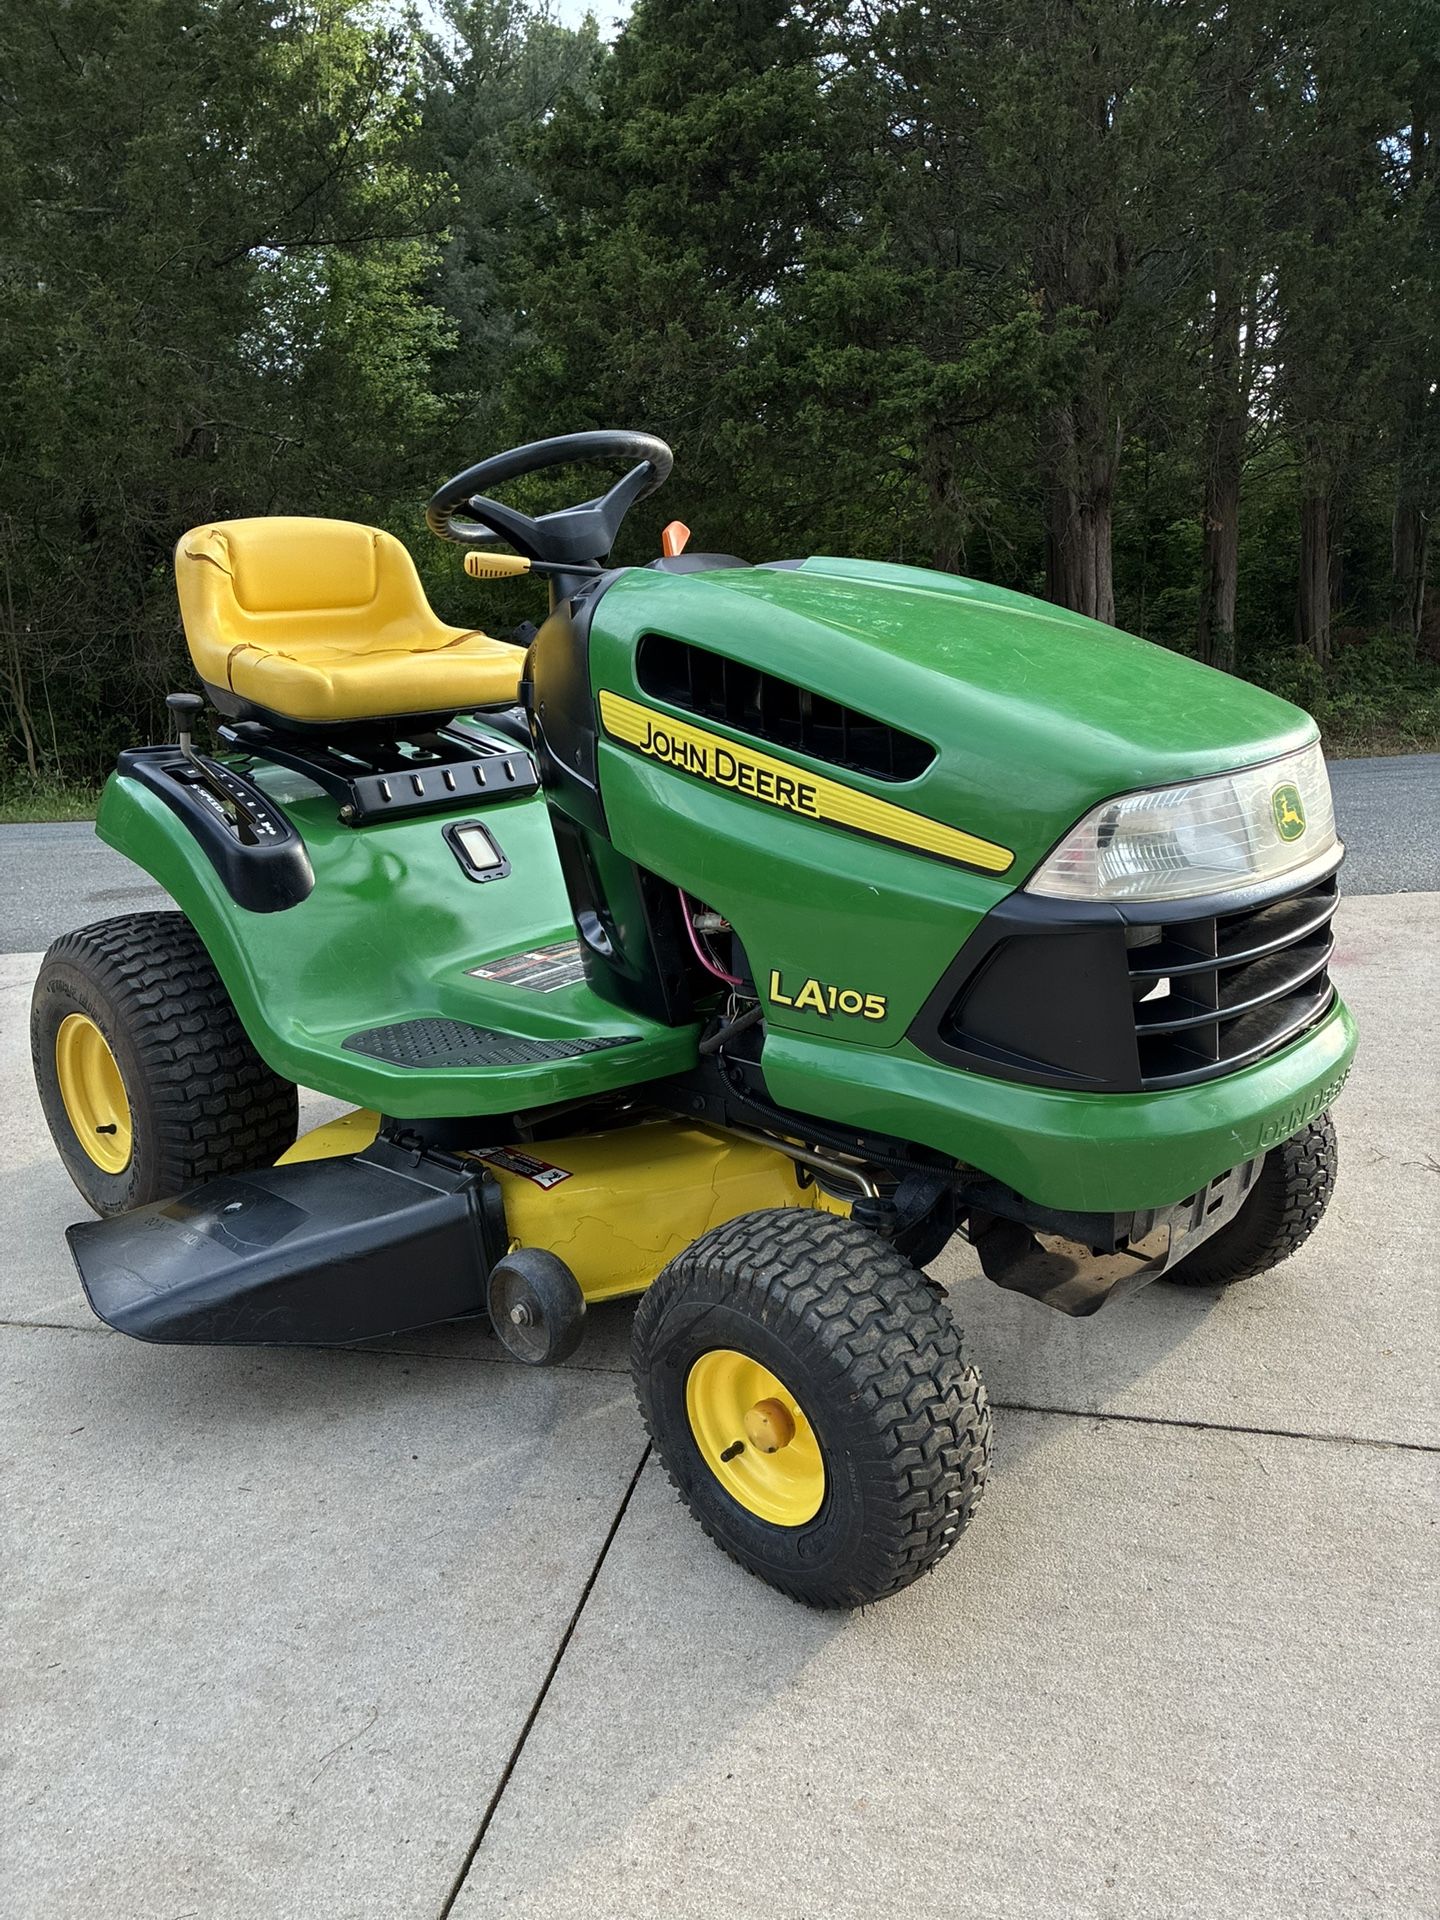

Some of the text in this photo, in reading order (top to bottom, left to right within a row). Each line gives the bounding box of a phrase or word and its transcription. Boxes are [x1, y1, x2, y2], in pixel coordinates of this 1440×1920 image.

[640, 722, 818, 814] JOHN DEERE
[769, 969, 887, 1020] LA105
[1243, 1102, 1307, 1156] JOHN
